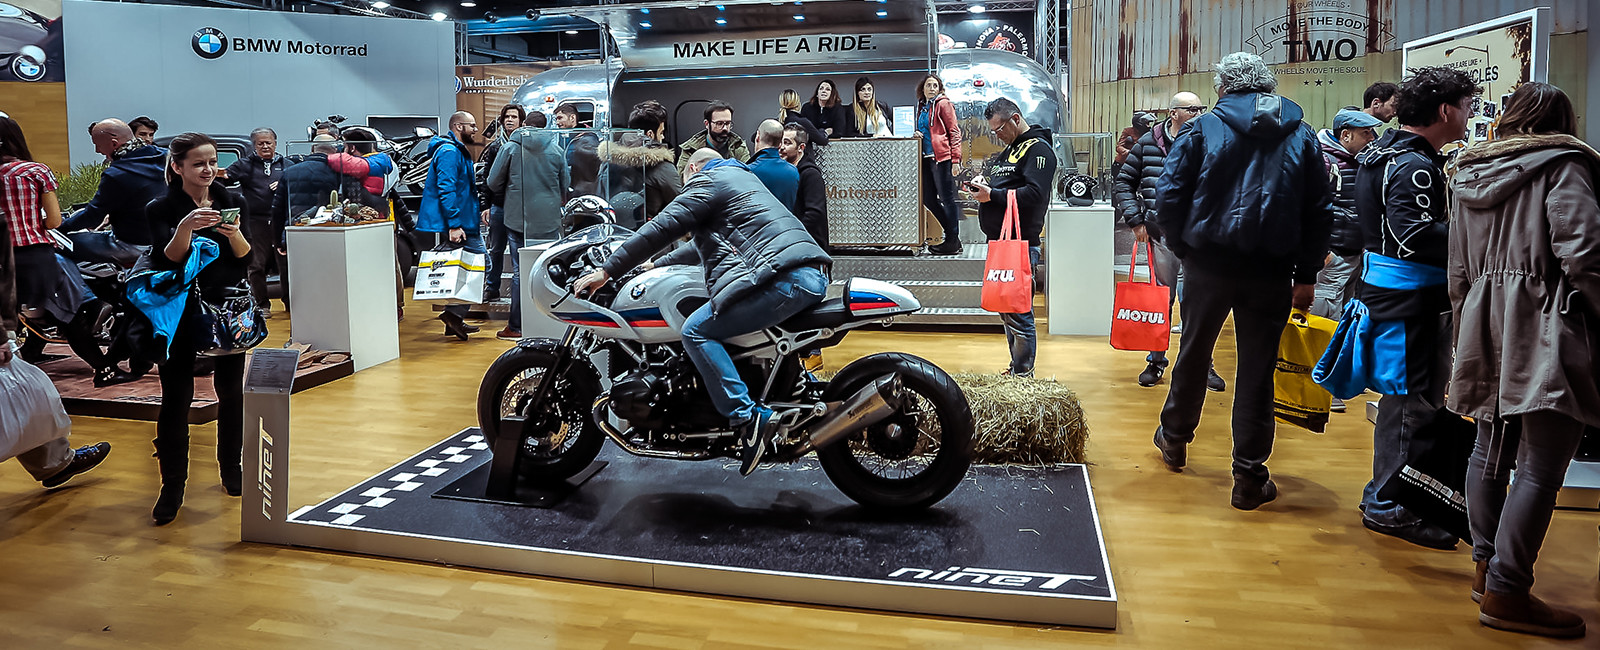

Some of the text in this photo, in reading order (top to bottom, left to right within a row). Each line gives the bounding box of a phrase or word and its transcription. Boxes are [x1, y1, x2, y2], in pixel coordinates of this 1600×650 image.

[1292, 0, 1345, 9] OUR WHEELS
[1270, 16, 1369, 35] MOVE THE BODY
[232, 37, 368, 57] BMW Motorrad
[673, 35, 877, 59] MAKE LIFE A RIDE.
[1002, 24, 1029, 57] PALERMO
[1282, 38, 1357, 62] TWO
[1273, 65, 1366, 75] WHEELS MOVE THE SOUL
[1459, 60, 1468, 68] ARE
[1468, 58, 1478, 66] LIKE
[463, 75, 528, 87] Wunderlich
[825, 185, 897, 199] Motorrad
[1116, 308, 1165, 324] MOTUL
